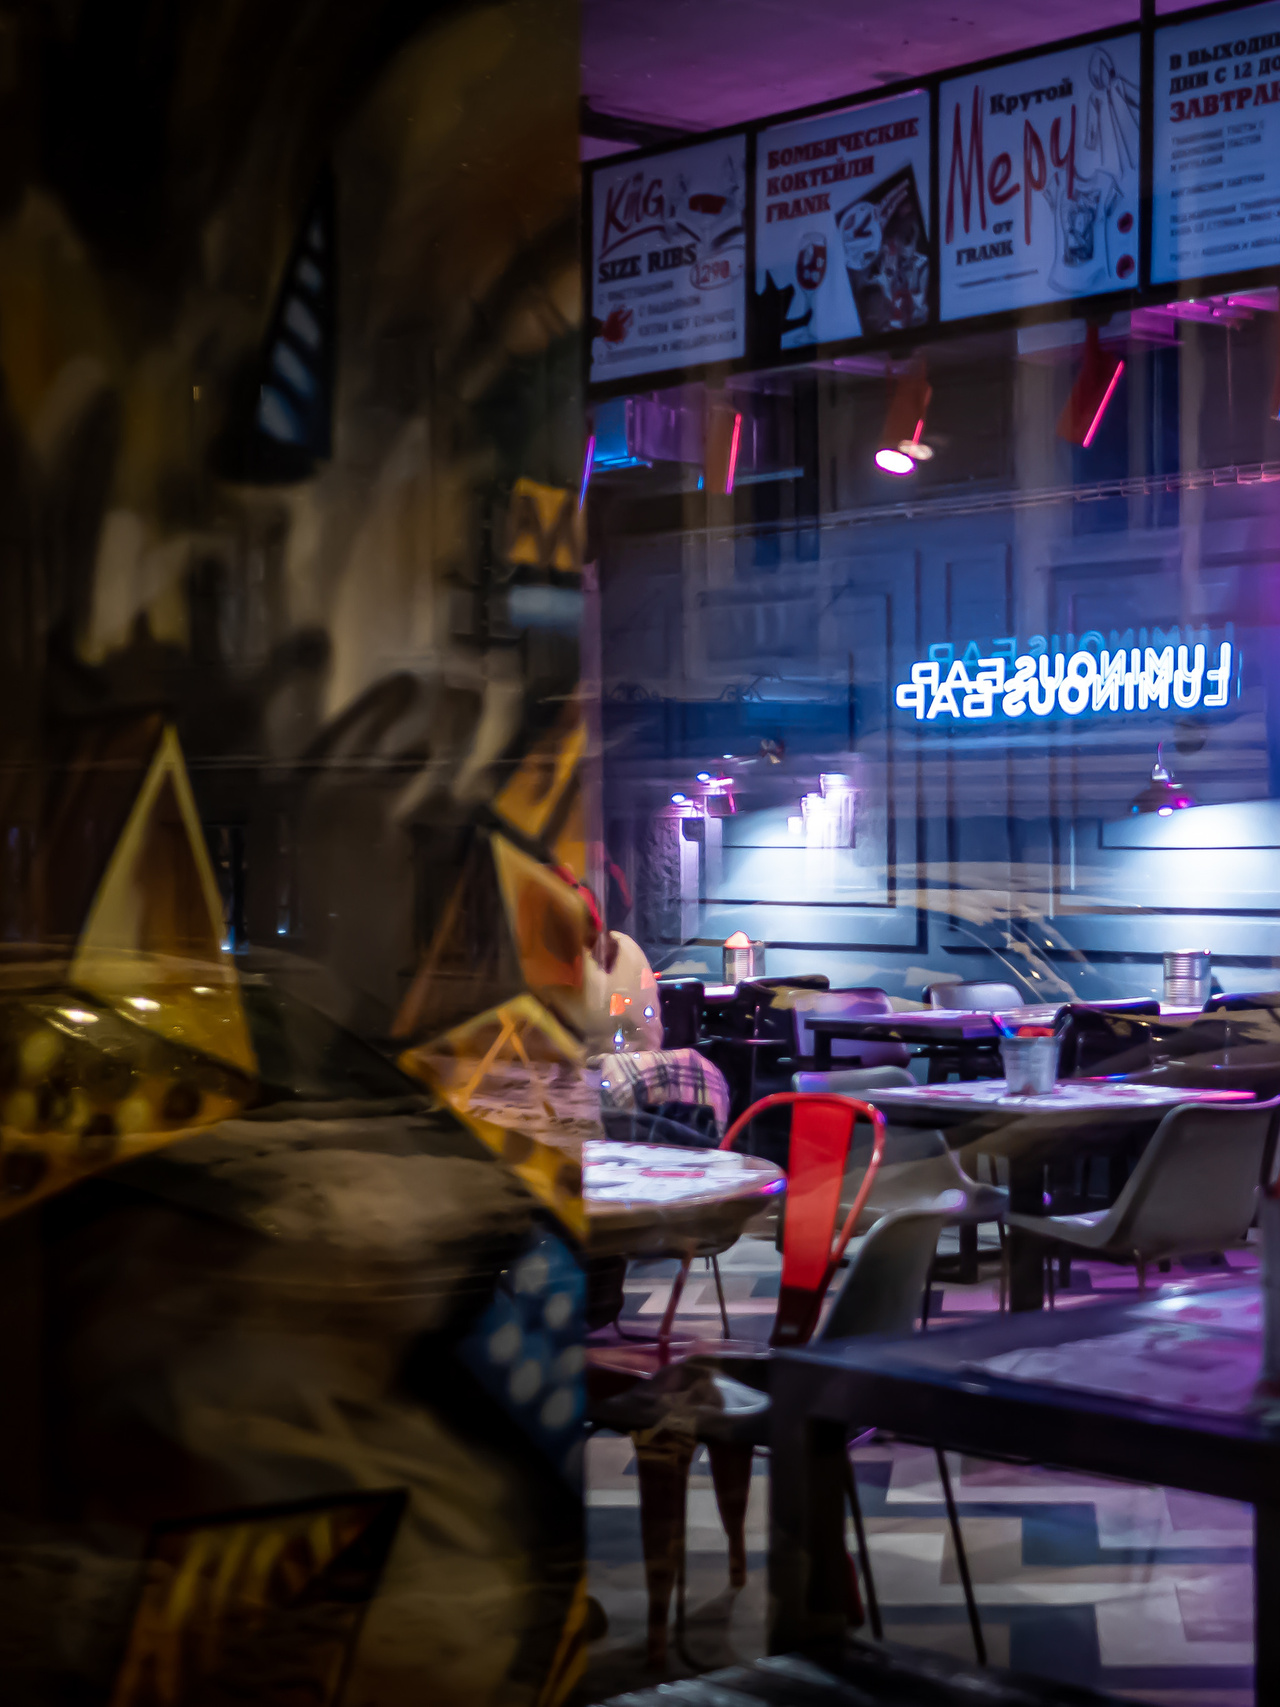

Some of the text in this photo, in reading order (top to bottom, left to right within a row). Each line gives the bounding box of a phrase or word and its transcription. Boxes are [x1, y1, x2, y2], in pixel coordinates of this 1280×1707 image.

[1169, 54, 1182, 71] В
[1169, 71, 1208, 95] ДНИ
[1234, 61, 1252, 80] 12
[990, 77, 1074, 116] Крутой
[766, 156, 875, 197] КОКТЕЙЛИ
[766, 193, 831, 224] FRANK
[598, 243, 697, 284] SIZE RIBS
[956, 239, 1014, 266] FRANK
